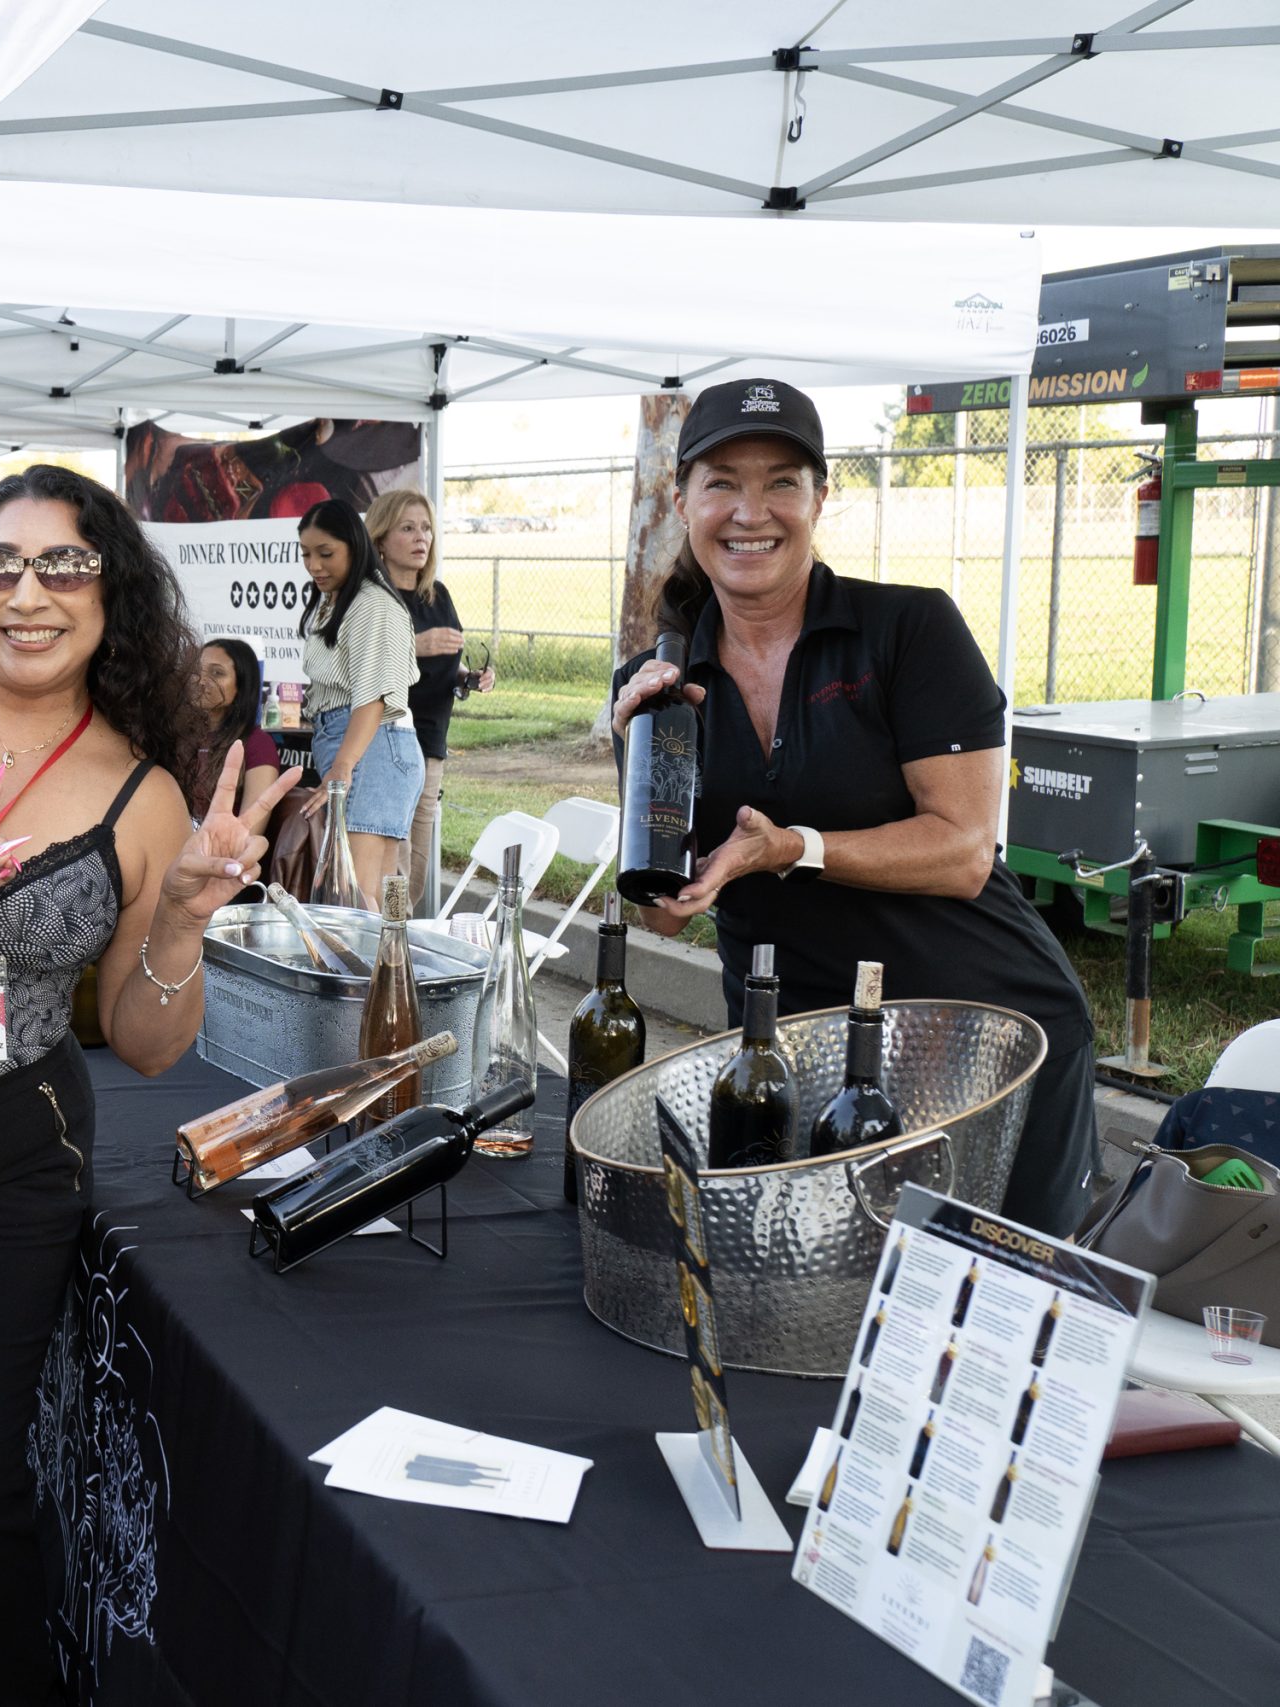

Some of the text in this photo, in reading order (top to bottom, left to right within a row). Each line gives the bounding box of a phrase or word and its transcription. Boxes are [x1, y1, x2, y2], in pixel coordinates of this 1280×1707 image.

[1036, 325, 1076, 345] 6026
[961, 368, 1127, 406] ZERO MISSION
[179, 543, 226, 565] DINNER
[204, 623, 225, 635] ENJOY
[278, 647, 301, 660] OWN
[1023, 765, 1093, 794] SUNBELT
[1032, 784, 1081, 800] RENTALS
[970, 1217, 1055, 1265] DISCOVER
